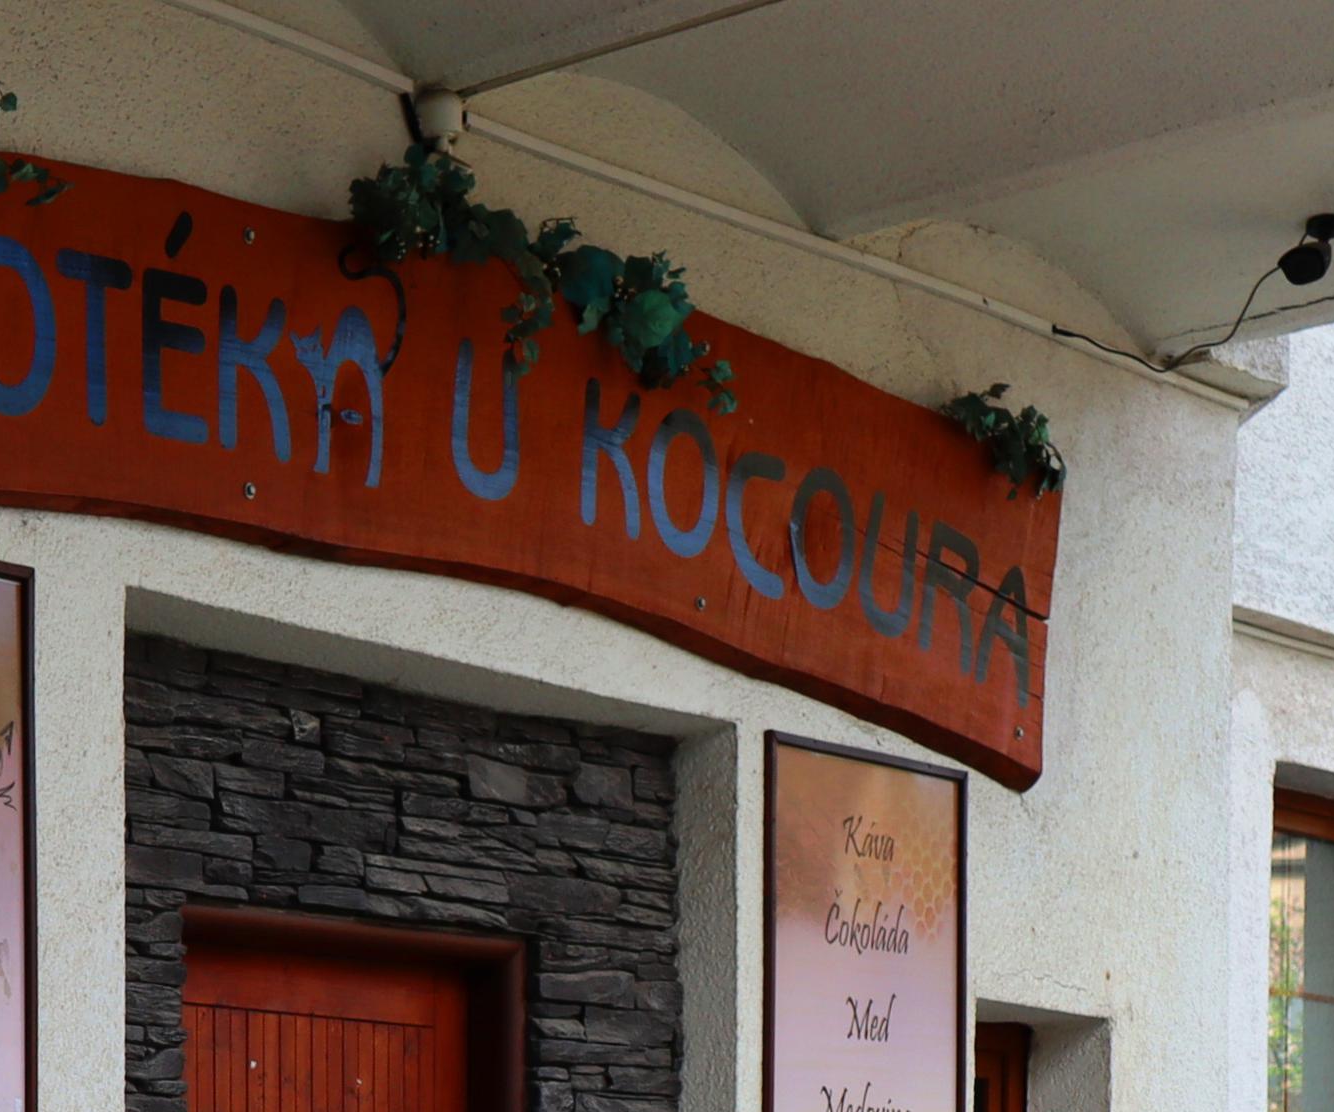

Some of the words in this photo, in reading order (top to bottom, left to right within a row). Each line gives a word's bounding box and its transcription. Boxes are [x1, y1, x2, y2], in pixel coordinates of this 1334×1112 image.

[452, 337, 519, 500] U
[580, 377, 1031, 709] KOCOURA
[843, 815, 897, 862] Káva
[824, 889, 910, 955] Čokoláda
[846, 993, 897, 1043] Med
